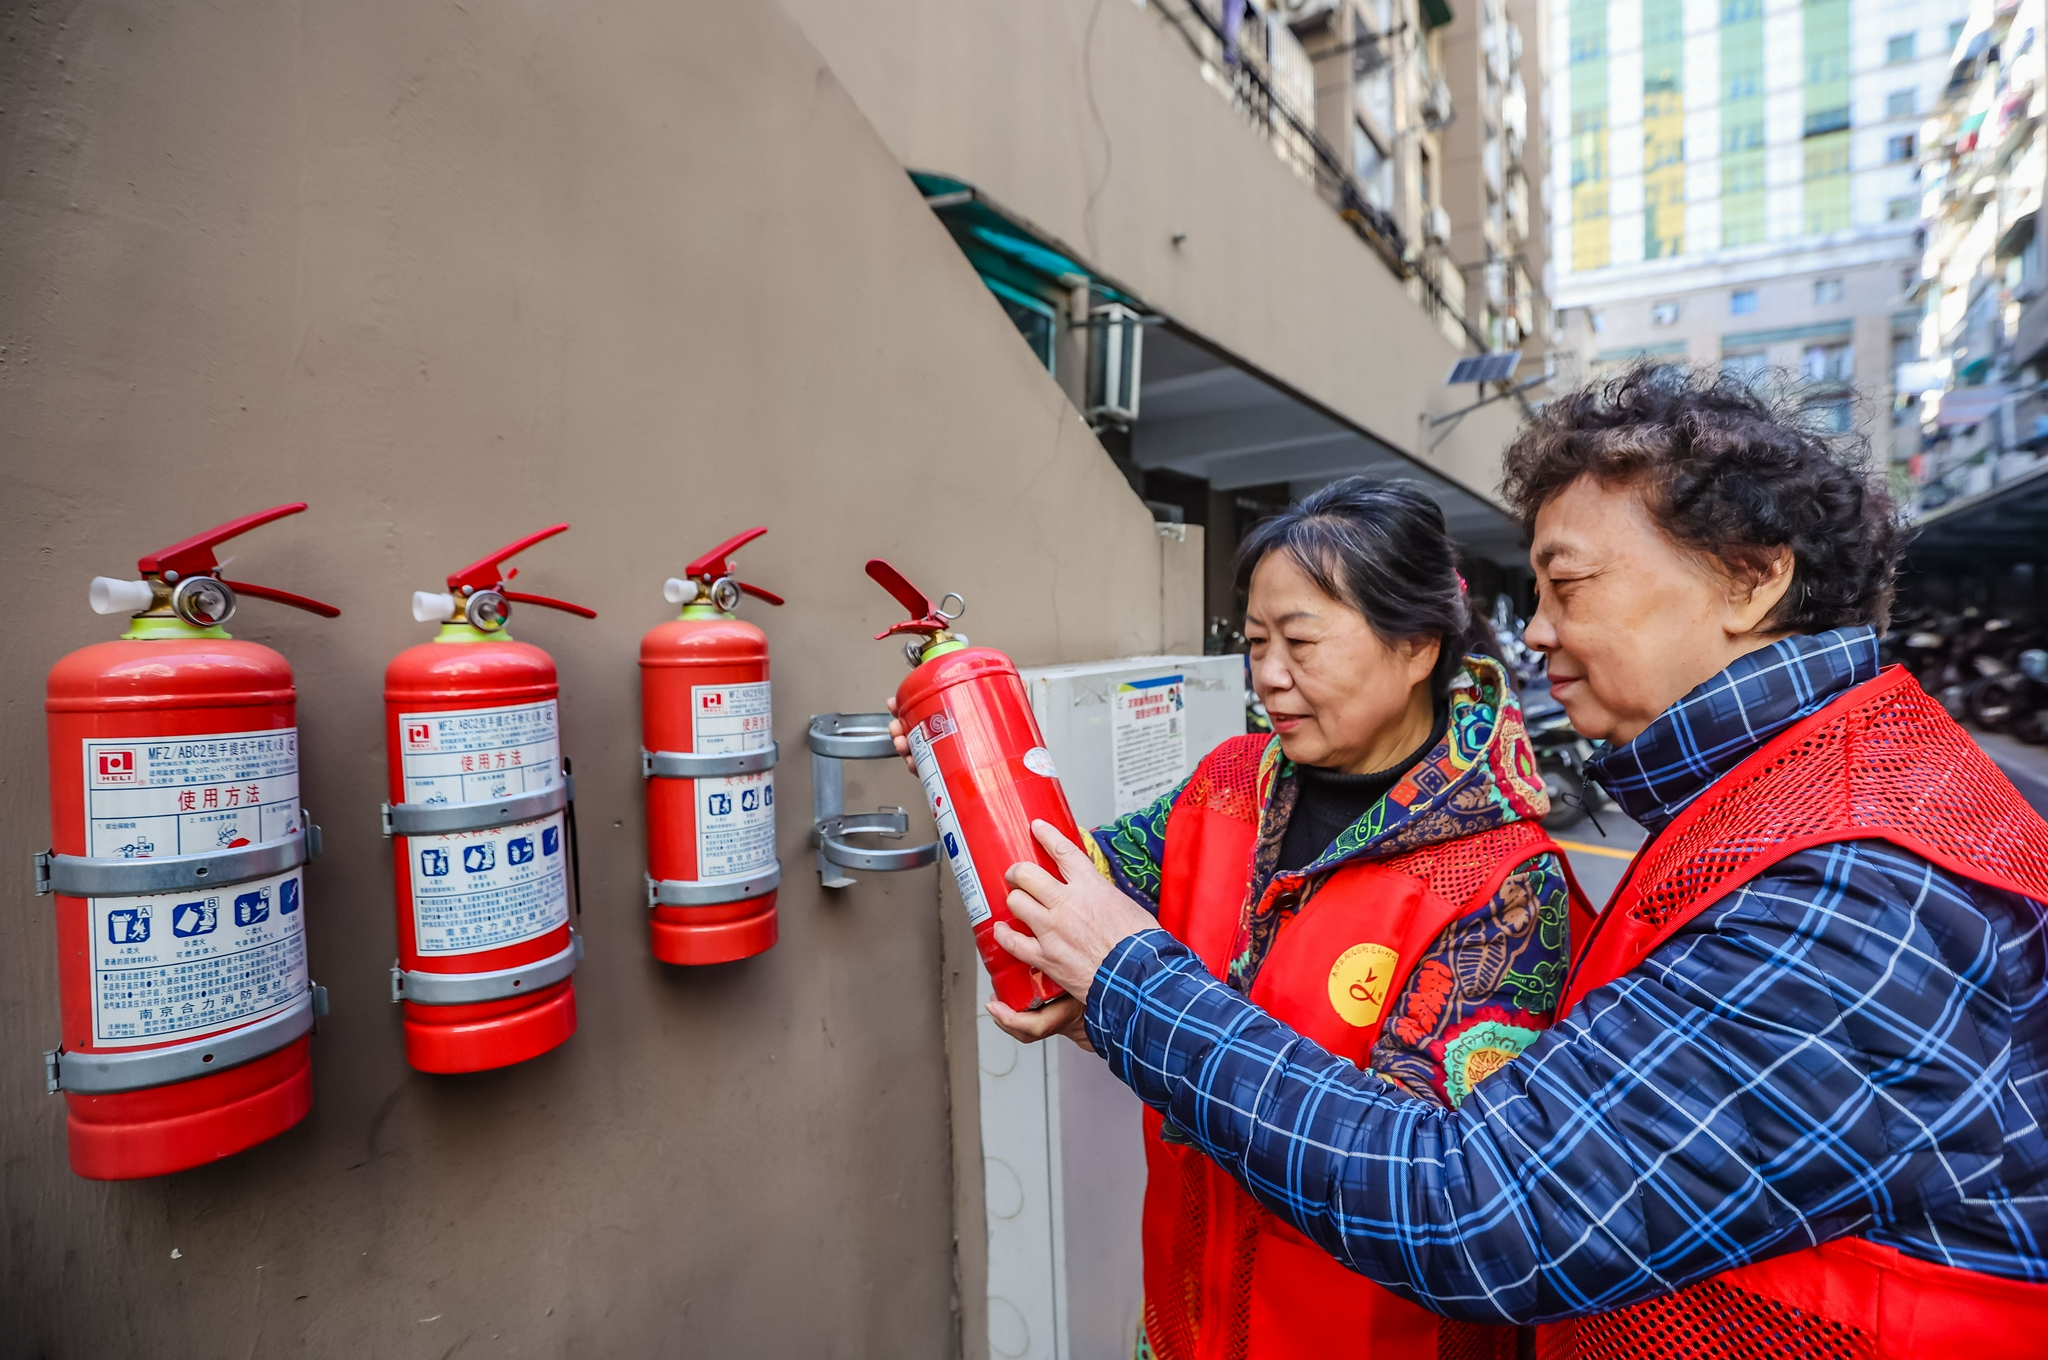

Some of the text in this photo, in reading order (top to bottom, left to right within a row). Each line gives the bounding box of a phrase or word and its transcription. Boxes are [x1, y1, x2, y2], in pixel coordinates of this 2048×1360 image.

[460, 750, 522, 772] 使用方法
[178, 784, 260, 812] 使用方法
[208, 899, 216, 907] B
[140, 907, 149, 916] A
[120, 946, 140, 955] A类火
[140, 974, 293, 1020] 南京合力消防器材厂
